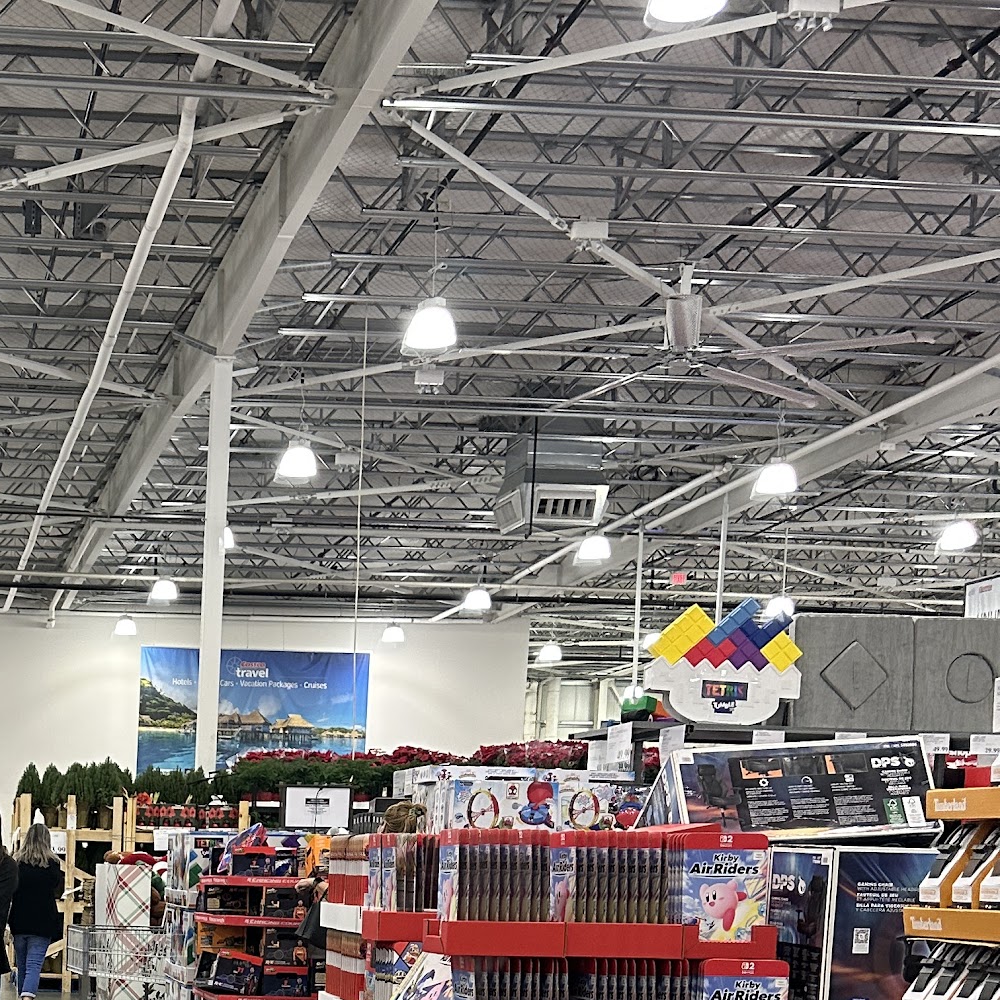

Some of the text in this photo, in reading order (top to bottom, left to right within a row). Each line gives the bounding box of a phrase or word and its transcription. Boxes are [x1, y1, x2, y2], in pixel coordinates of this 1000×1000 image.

[236, 668, 269, 678] travel
[172, 678, 327, 690] Hotels Cars Vacation Packages Cruises
[705, 684, 744, 697] TETRIS
[870, 756, 901, 769] DPS
[933, 797, 967, 812] Timberland
[713, 854, 739, 863] Kirby
[772, 873, 796, 891] DPS
[910, 916, 942, 931] Timberland
[735, 981, 761, 990] Kirby
